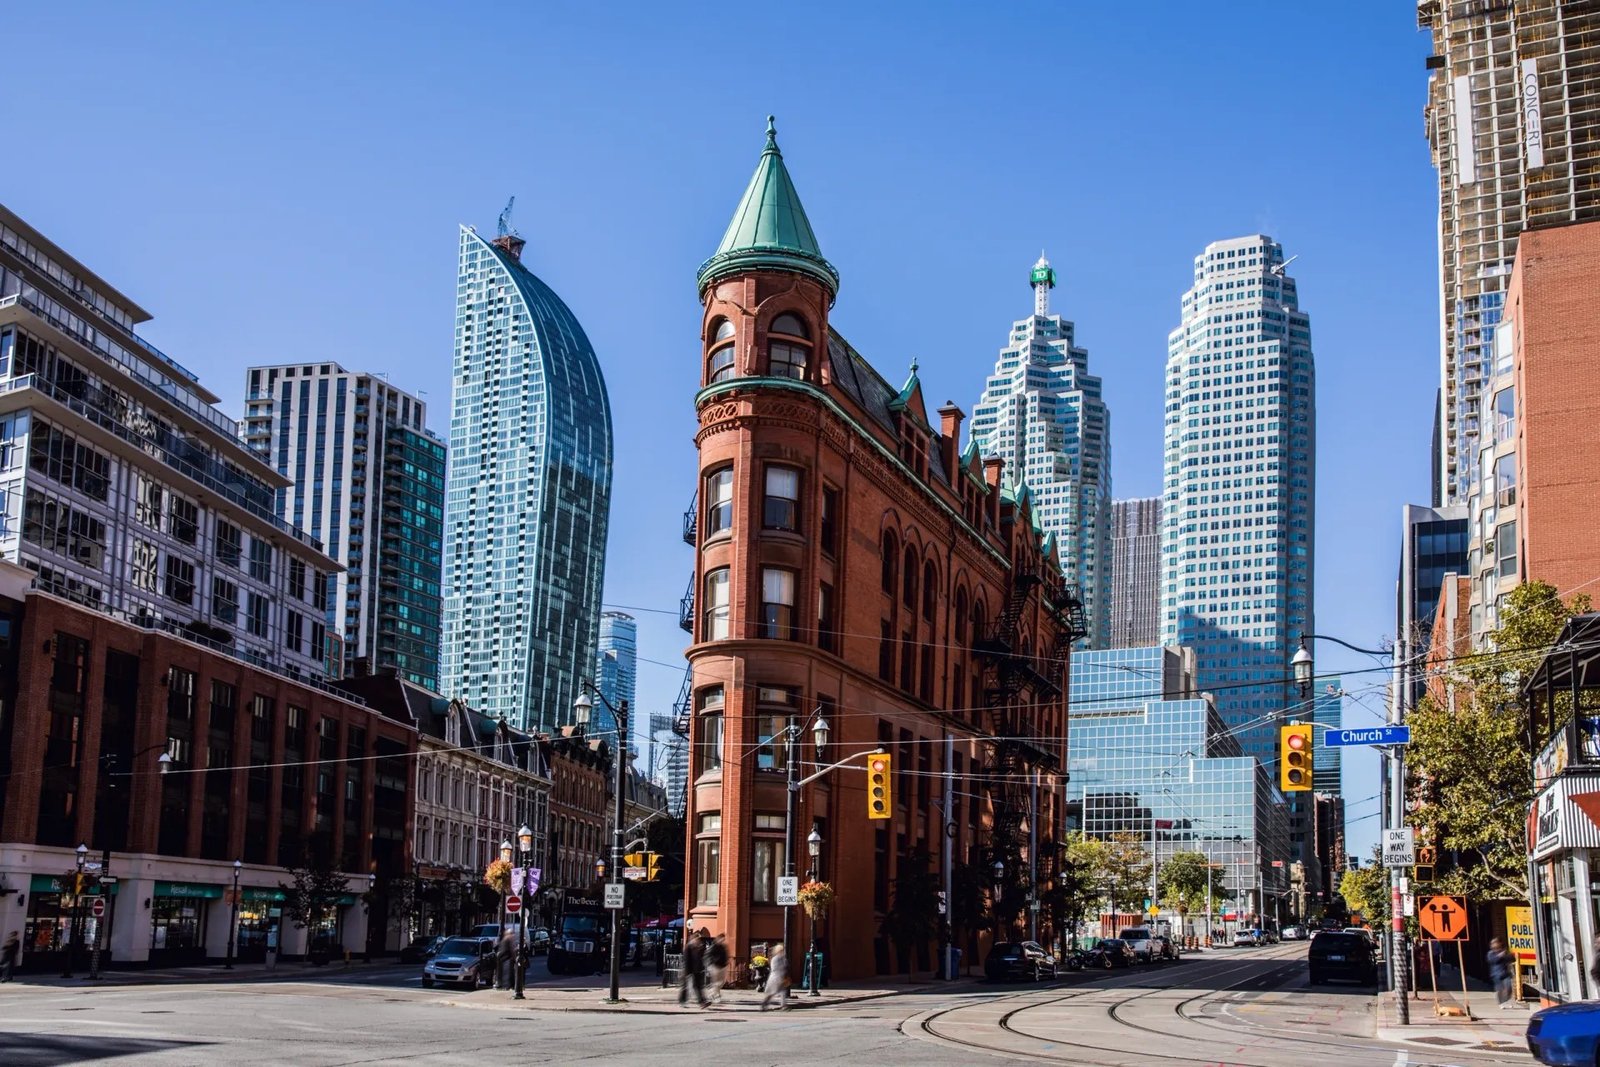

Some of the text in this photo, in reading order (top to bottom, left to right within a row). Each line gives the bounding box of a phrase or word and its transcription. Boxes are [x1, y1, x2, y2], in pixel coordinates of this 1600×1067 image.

[1525, 73, 1540, 148] CONCERT
[1035, 271, 1046, 279] TD
[1341, 728, 1392, 742] Church St
[1389, 831, 1405, 841] ONE
[1390, 842, 1405, 852] WAY
[1384, 853, 1413, 863] BEGINS
[610, 886, 619, 894] NO
[567, 896, 580, 905] The
[778, 895, 796, 903] BEGINS
[1511, 924, 1534, 936] PUBL
[1510, 937, 1534, 949] PARKI
